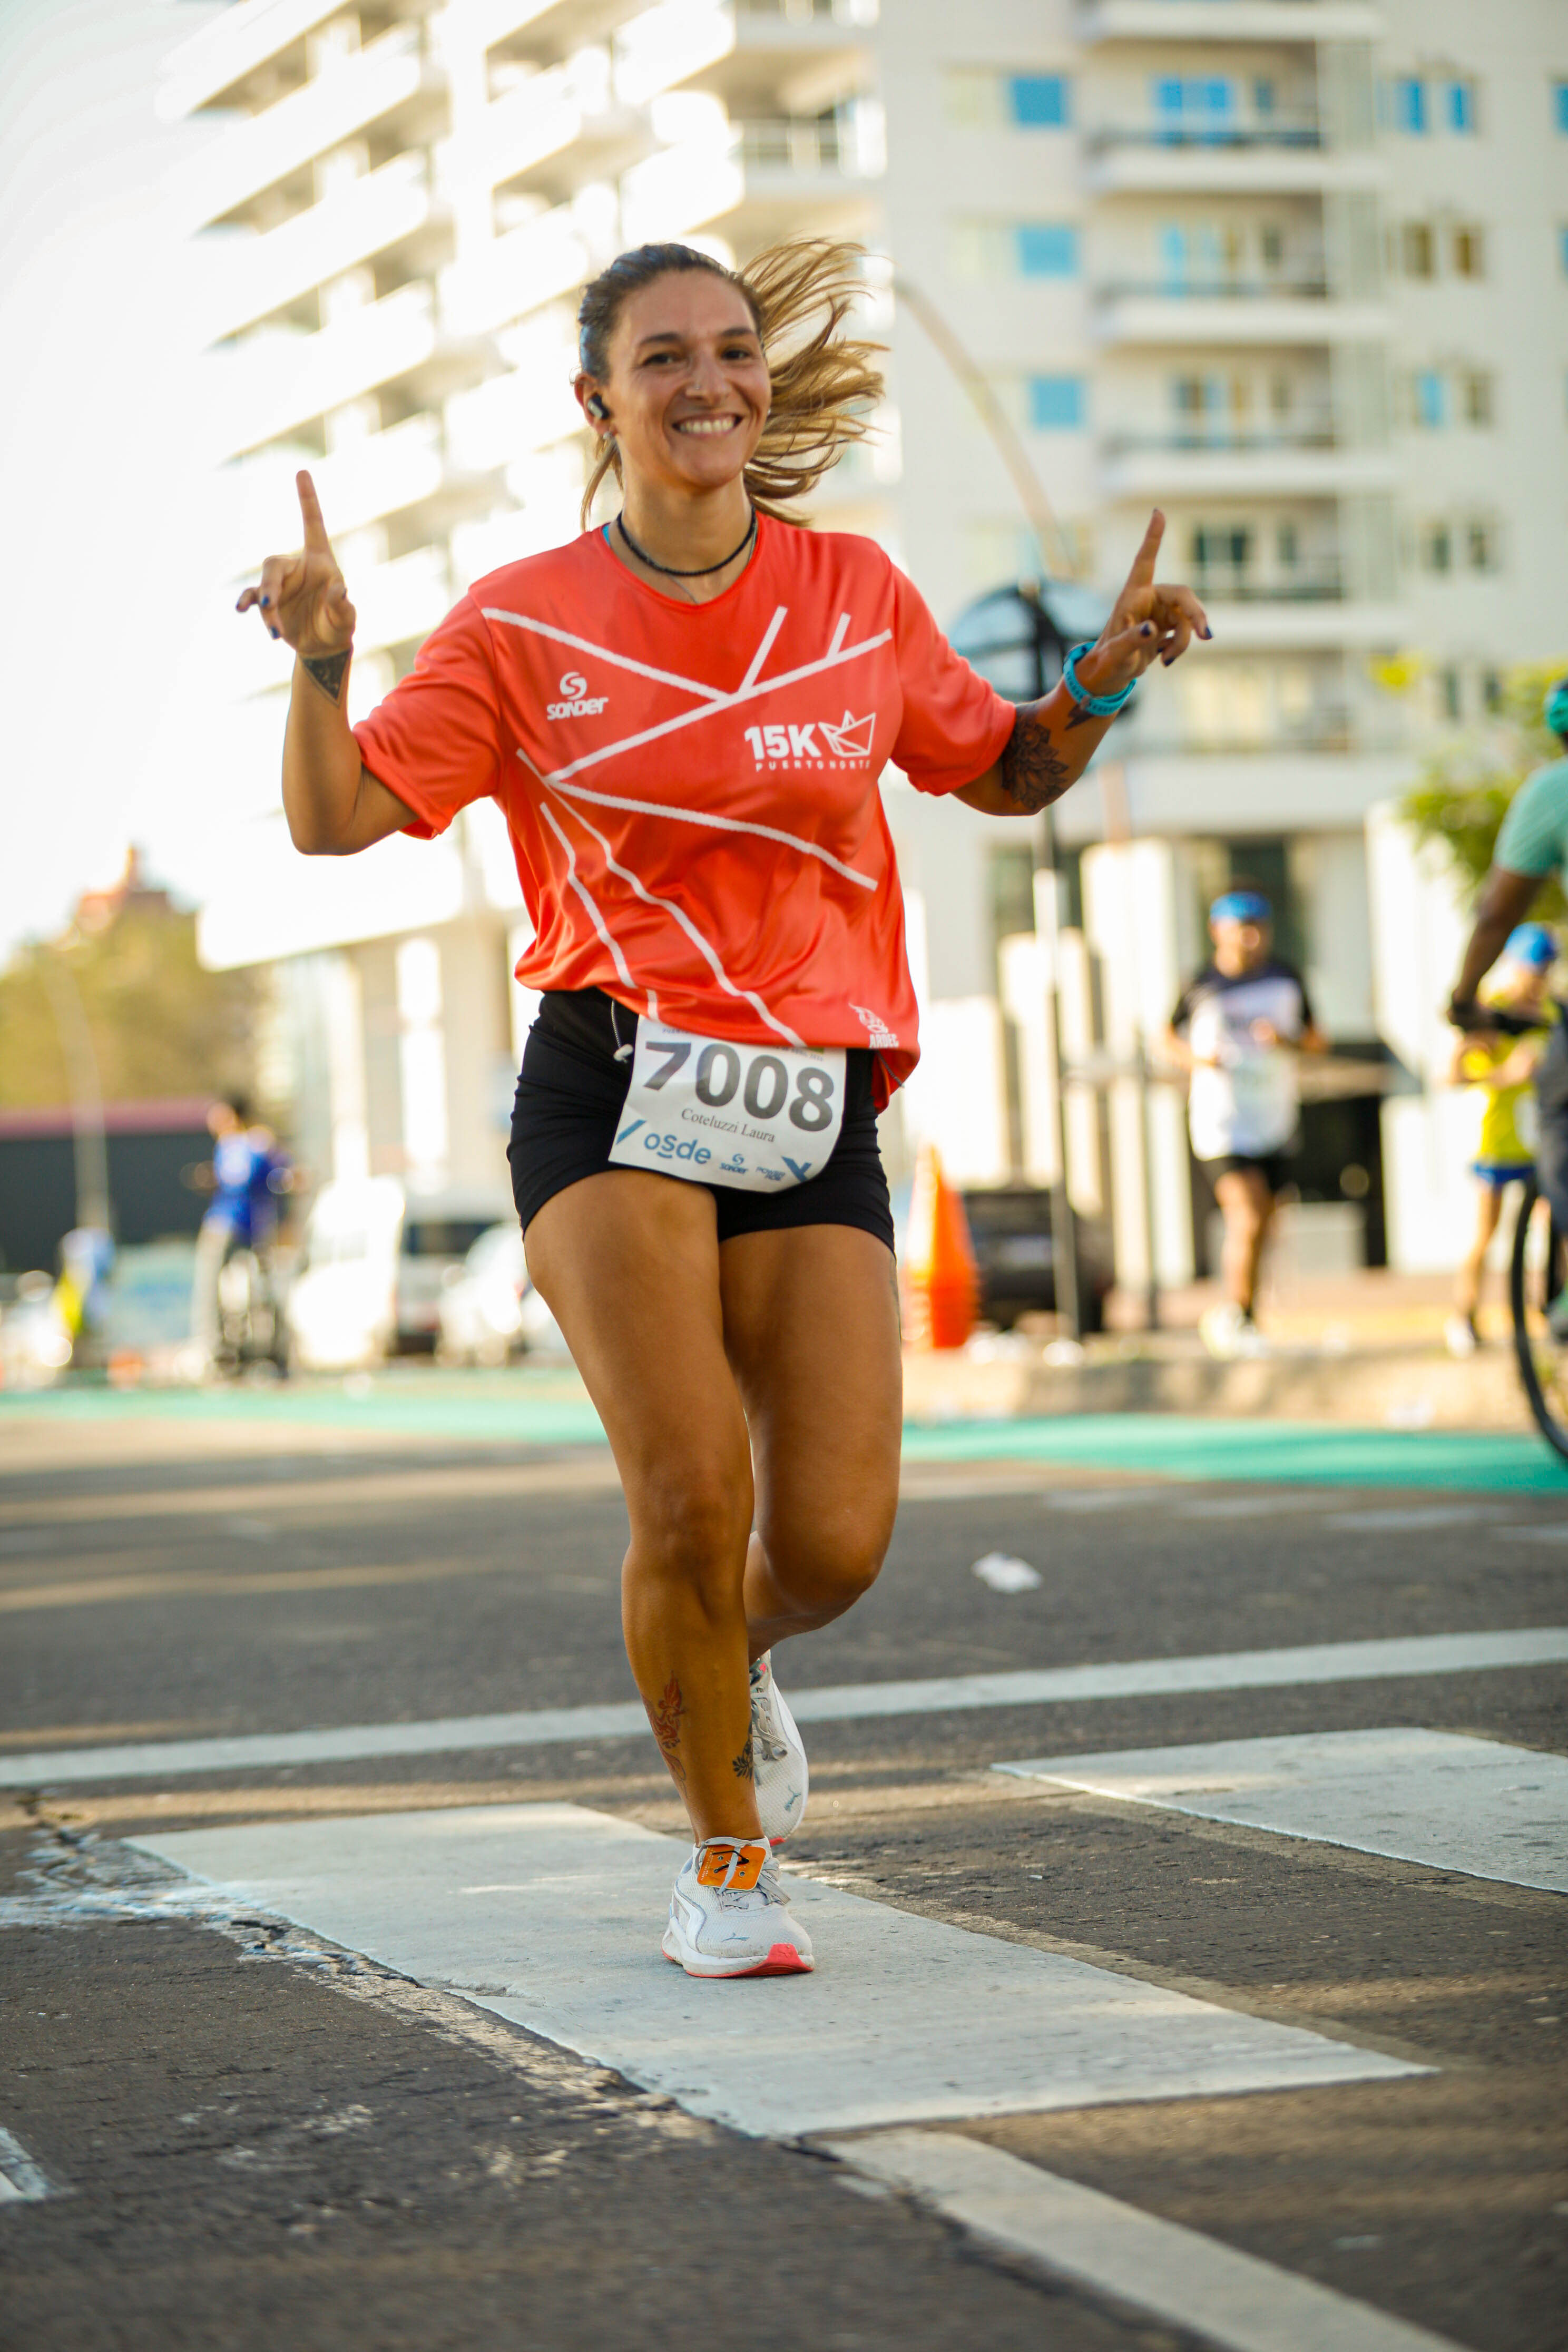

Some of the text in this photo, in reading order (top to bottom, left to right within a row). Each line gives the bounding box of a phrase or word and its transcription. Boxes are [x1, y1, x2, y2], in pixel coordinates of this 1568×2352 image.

[744, 723, 822, 760] 15K
[643, 1041, 835, 1132] 7008
[681, 1108, 775, 1142] Coteluzzi Laura
[643, 1133, 711, 1164] osde
